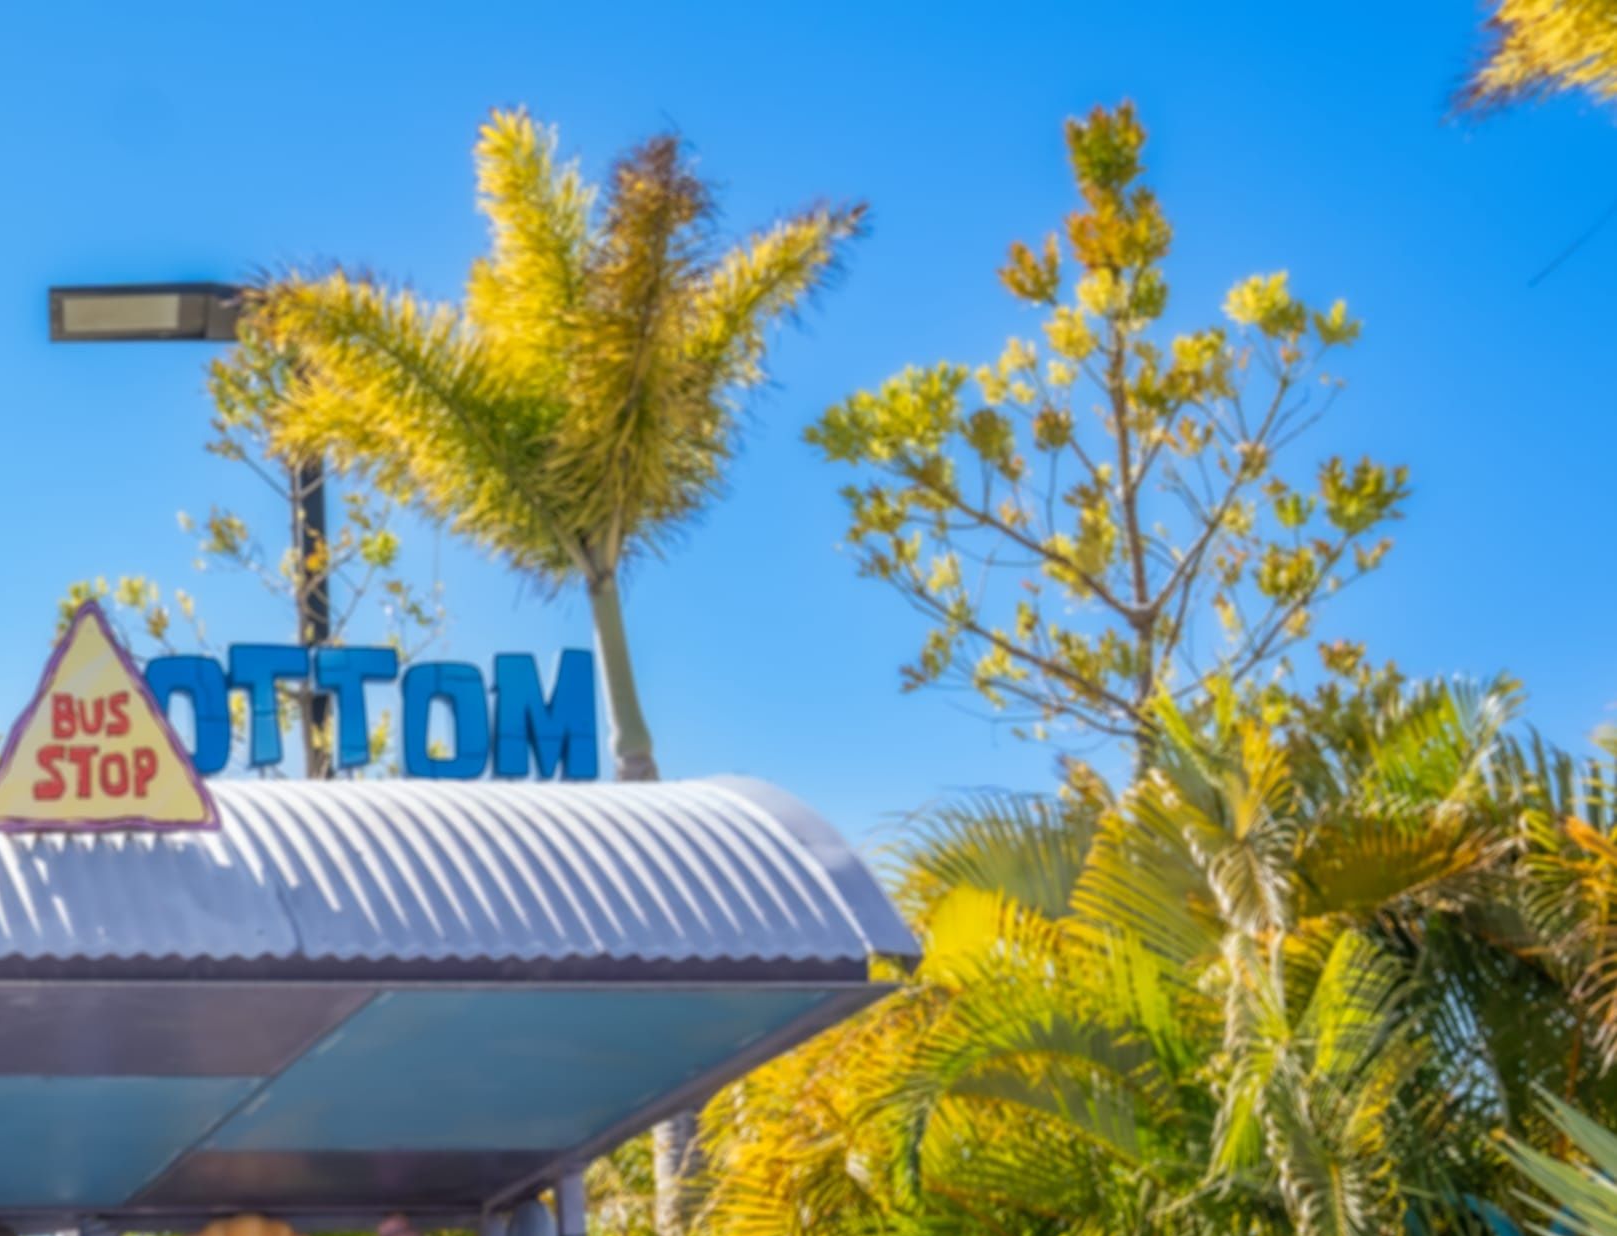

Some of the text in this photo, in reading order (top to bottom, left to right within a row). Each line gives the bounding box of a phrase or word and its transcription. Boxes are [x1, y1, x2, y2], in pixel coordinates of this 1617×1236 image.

[51, 691, 131, 740] BUS
[145, 643, 599, 779] OTTOM
[33, 744, 159, 801] STOP
